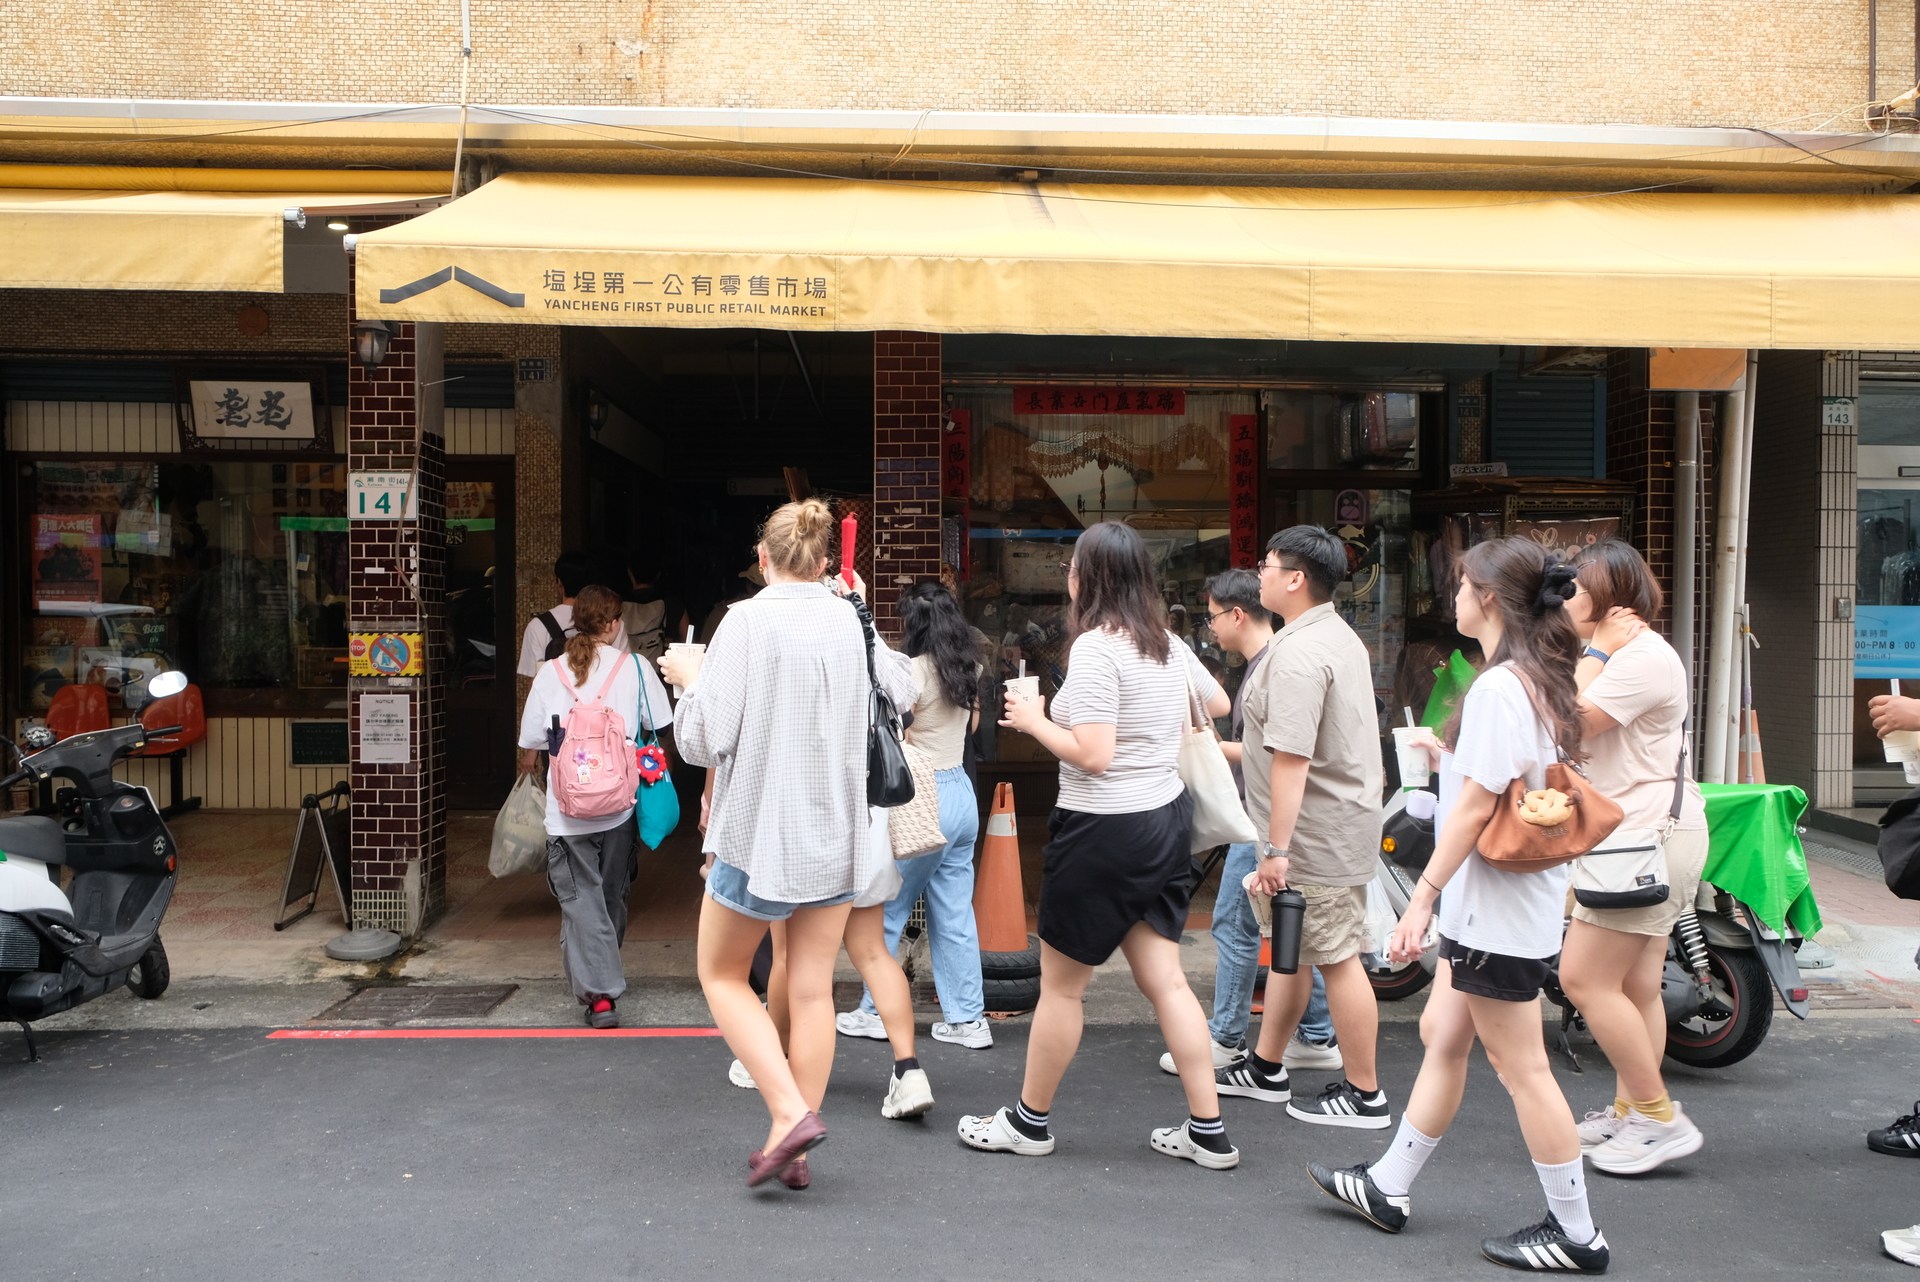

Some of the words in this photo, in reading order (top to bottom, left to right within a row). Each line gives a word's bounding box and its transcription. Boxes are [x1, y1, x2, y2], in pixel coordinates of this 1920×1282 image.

[543, 269, 827, 299] 塩埕第一公有零售市場
[544, 299, 620, 312] YANCHENG
[624, 302, 662, 312] FIRST
[667, 303, 716, 314] PUBLIC
[720, 304, 765, 314] RETAIL
[770, 305, 827, 317] MARKET
[522, 371, 540, 380] 141
[1828, 413, 1849, 424] 143
[1335, 600, 1380, 613] 斯汀
